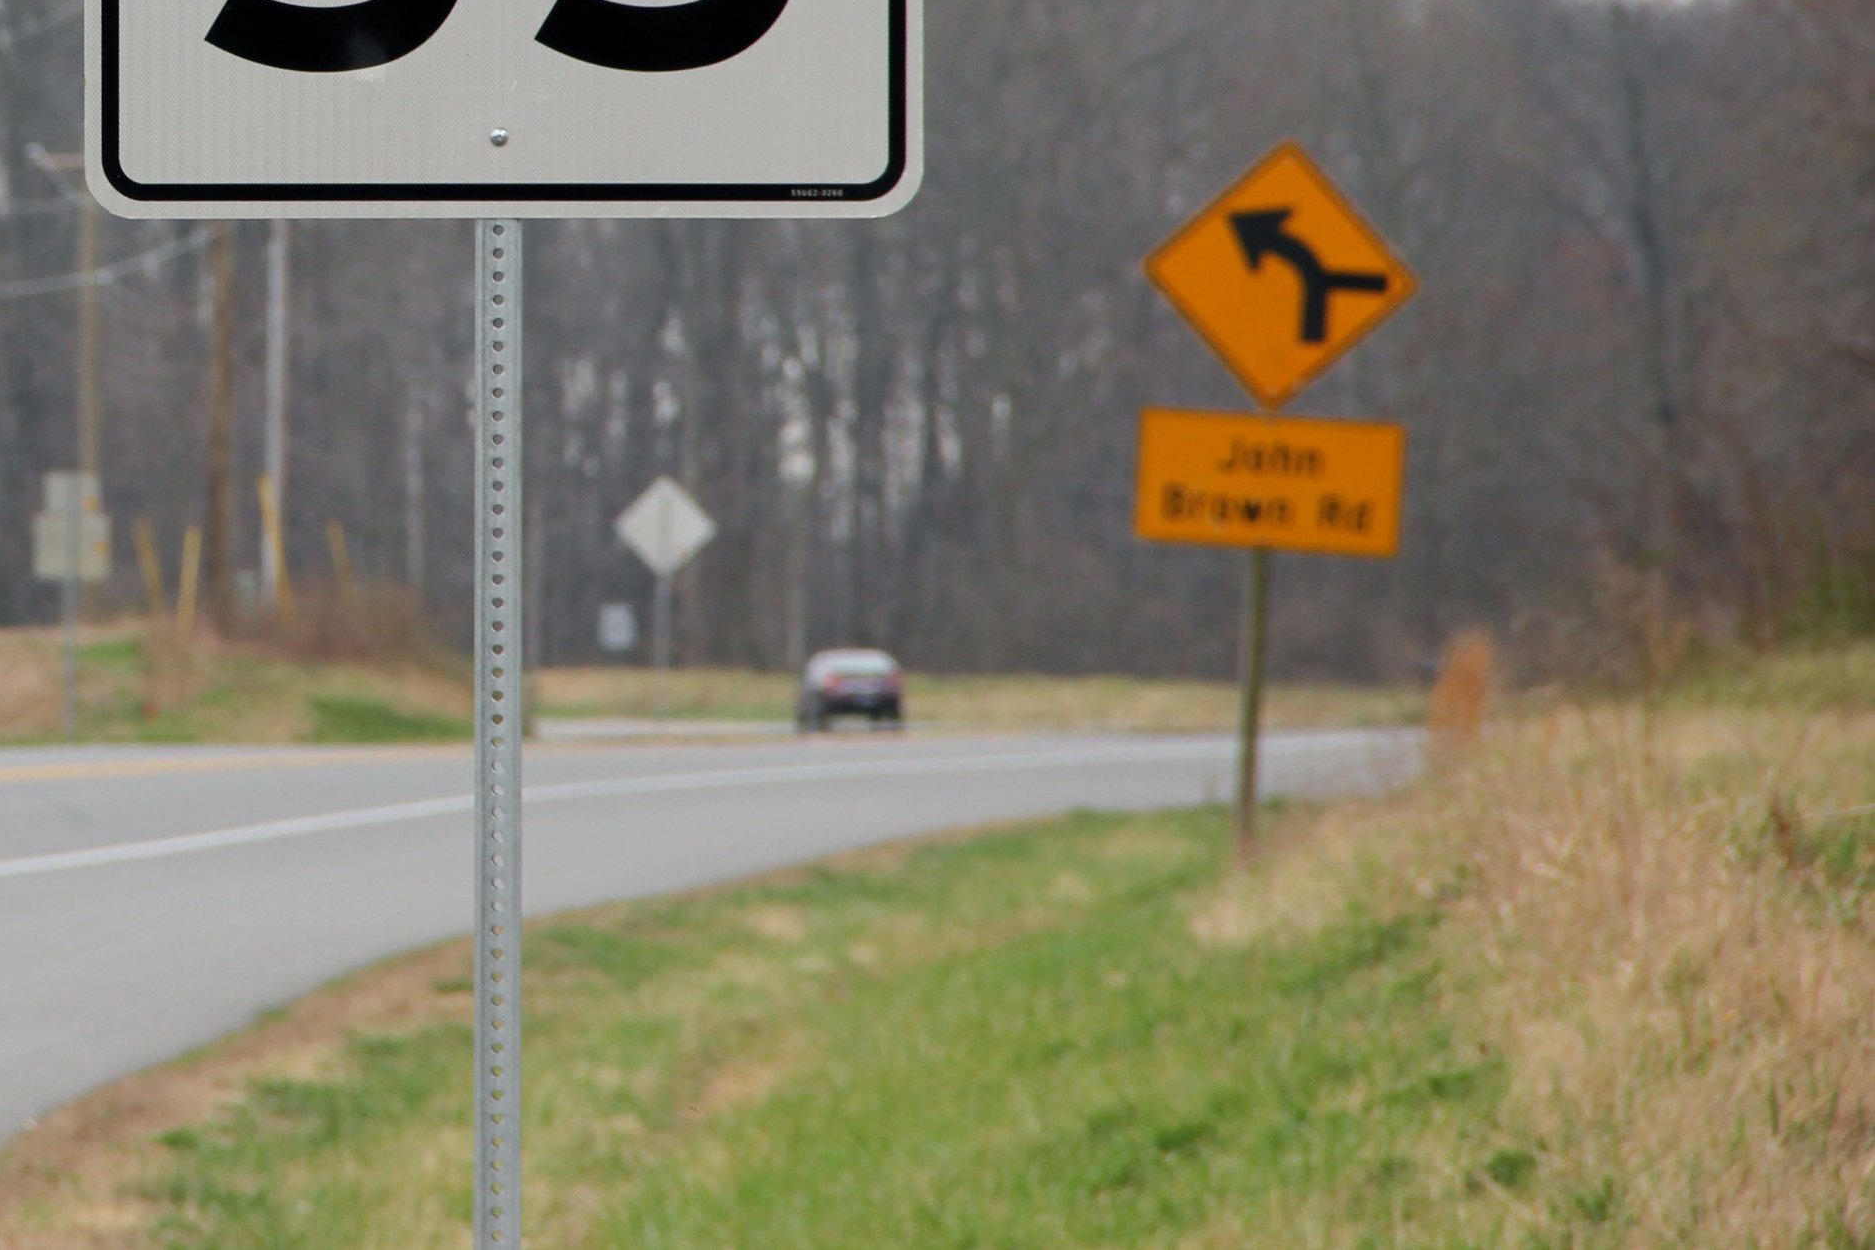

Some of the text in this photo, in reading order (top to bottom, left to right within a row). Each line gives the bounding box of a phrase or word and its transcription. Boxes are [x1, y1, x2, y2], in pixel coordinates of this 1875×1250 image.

[1216, 435, 1322, 477] John
[1162, 481, 1372, 535] Brown Rd
